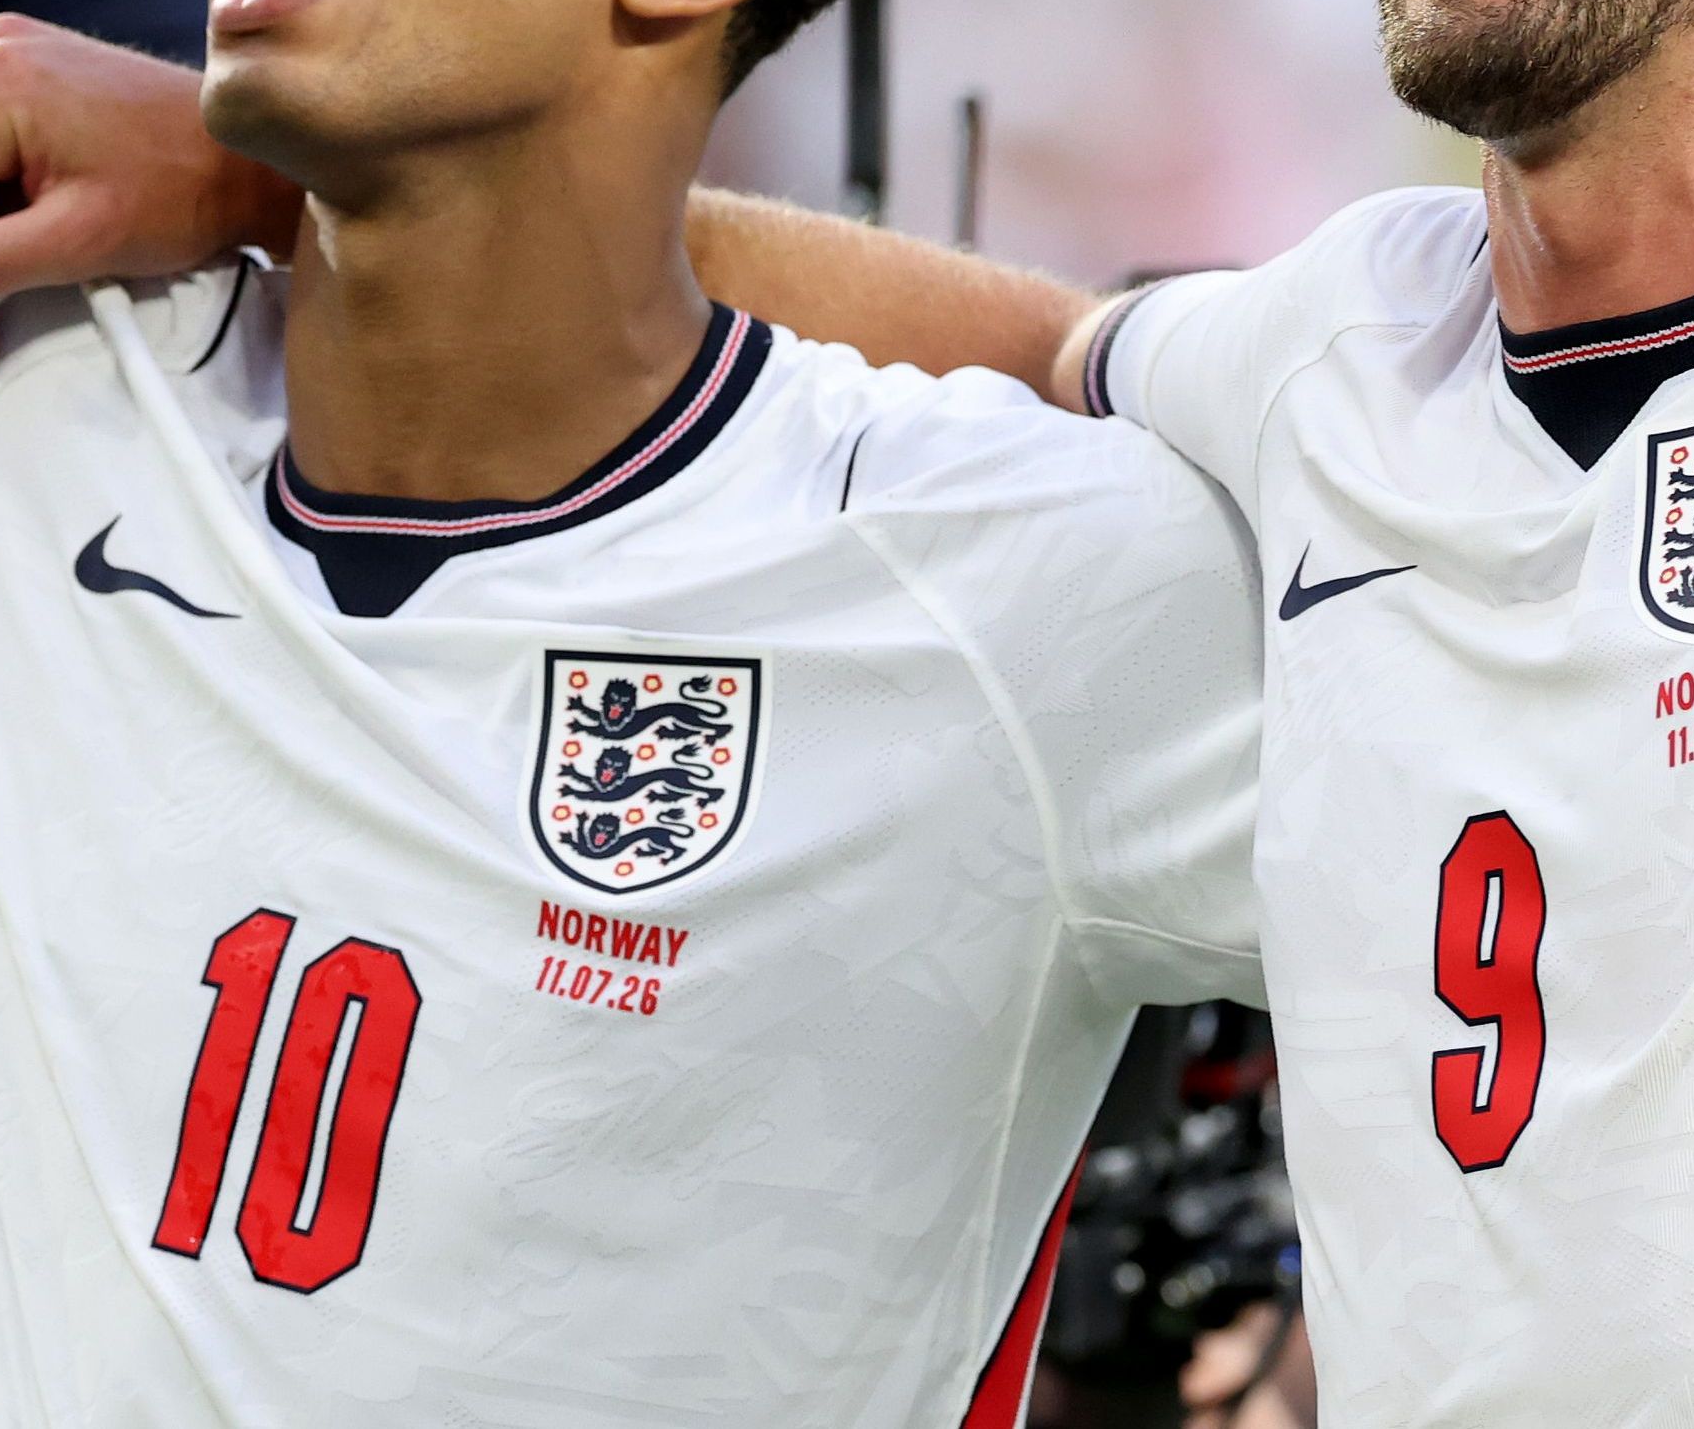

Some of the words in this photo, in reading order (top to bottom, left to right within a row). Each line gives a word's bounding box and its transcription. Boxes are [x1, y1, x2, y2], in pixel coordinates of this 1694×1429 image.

[534, 955, 661, 1017] 11.07.26
[536, 899, 688, 968] NORWAY
[1431, 809, 1547, 1175] 9
[151, 907, 423, 1296] 10
